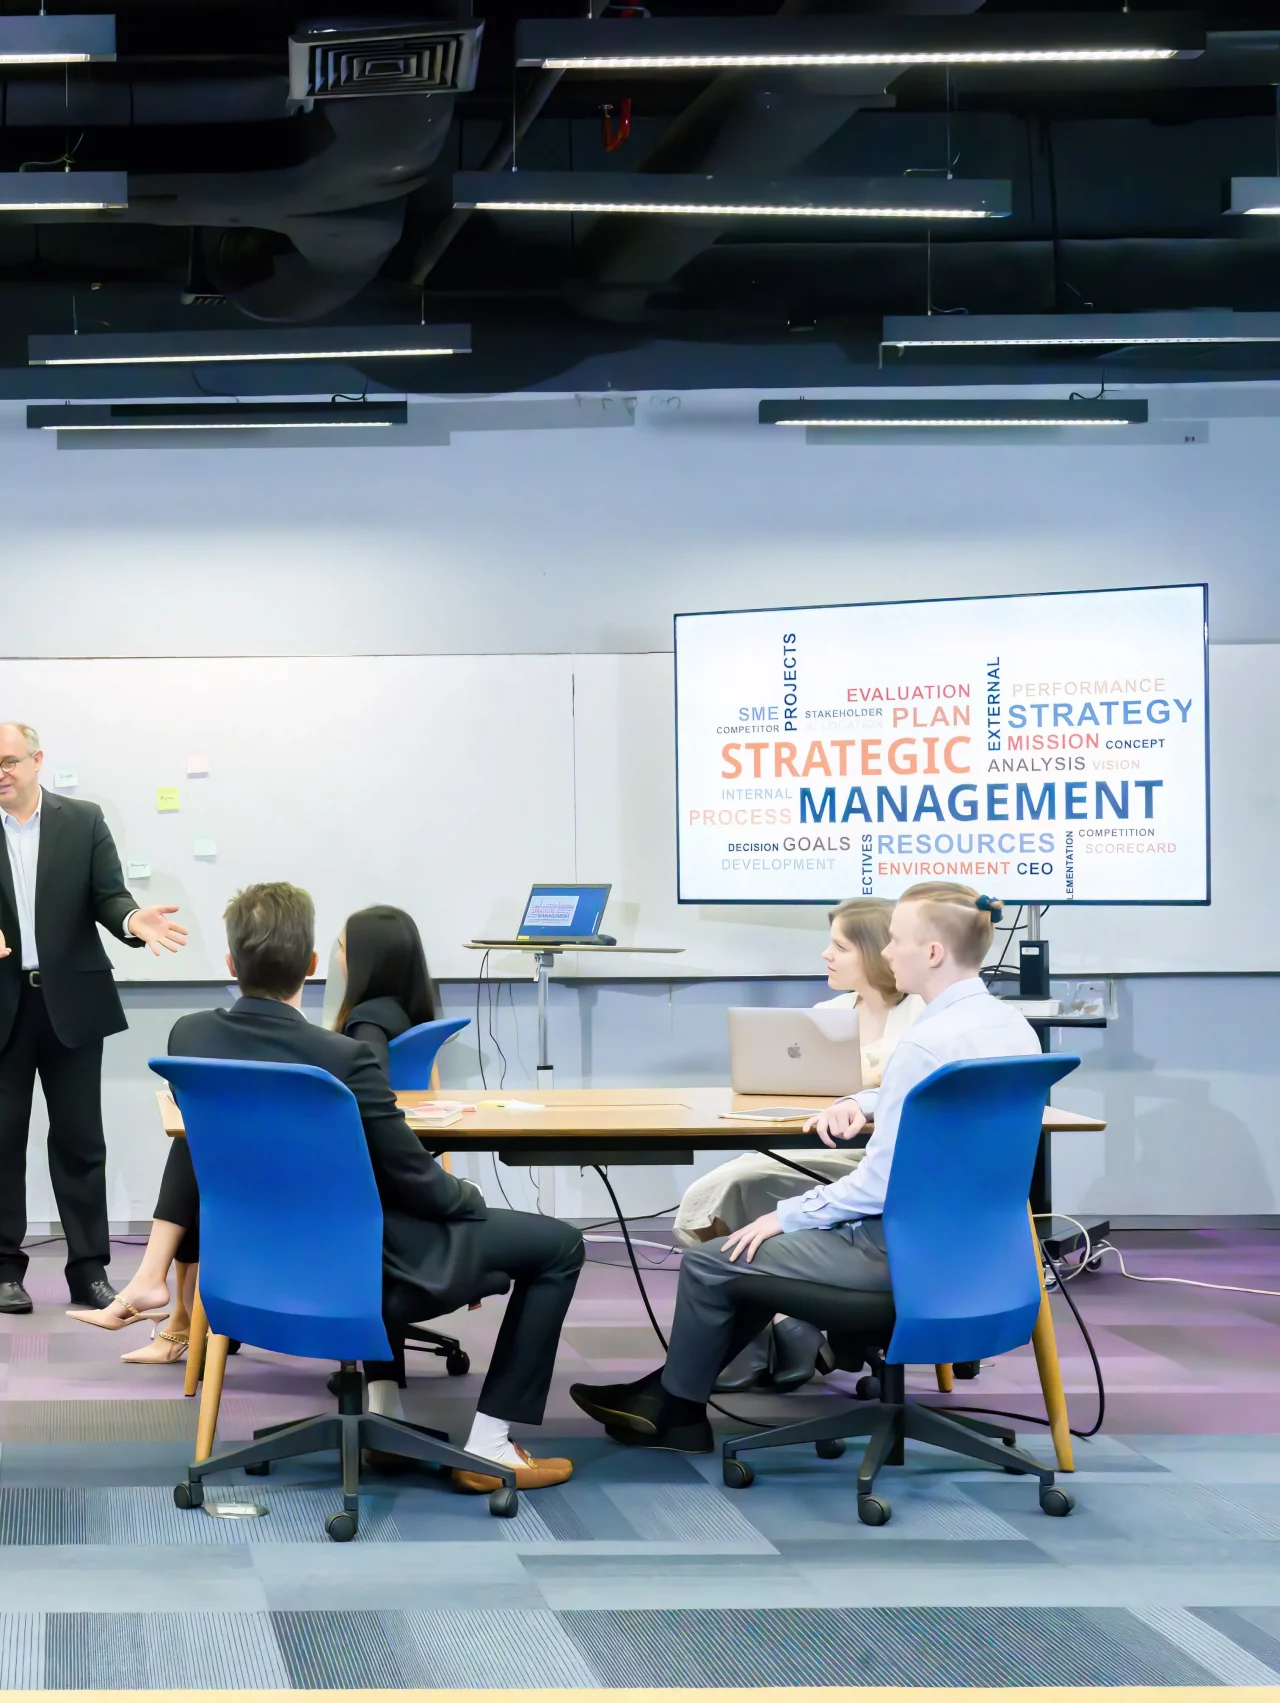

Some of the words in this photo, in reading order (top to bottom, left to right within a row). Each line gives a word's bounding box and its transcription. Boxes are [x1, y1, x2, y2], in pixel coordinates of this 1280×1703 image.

[783, 634, 797, 731] PROJECTS
[1013, 678, 1165, 697] PERFORMANCE
[848, 684, 969, 702] EVALUATION
[987, 657, 1000, 751] EXTERNAL
[739, 706, 778, 721] SME
[805, 708, 882, 718] STAKEHOLDER
[893, 705, 970, 728] PLAN
[1008, 699, 1192, 728] STRATEGY
[717, 725, 779, 734] COMPETITOR
[1008, 733, 1098, 750] MISSION
[1106, 739, 1165, 749] CONCEPT
[722, 736, 971, 779] STRATEGIC
[988, 757, 1085, 772] ANALYSIS
[1093, 760, 1139, 770] VISION
[722, 788, 792, 800] INTERNAL
[800, 780, 1163, 823] MANAGEMENT
[690, 809, 791, 826] PROCESS
[1079, 829, 1154, 837] COMPETITION
[729, 843, 778, 851] DECISION
[783, 837, 850, 851] GOALS
[878, 833, 1054, 854] RESOURCES
[1086, 843, 1176, 853] SCORECARD
[722, 859, 835, 870] DEVELOPMENT
[879, 862, 1010, 875] ENVIRONMENT
[1017, 863, 1053, 875] CEO
